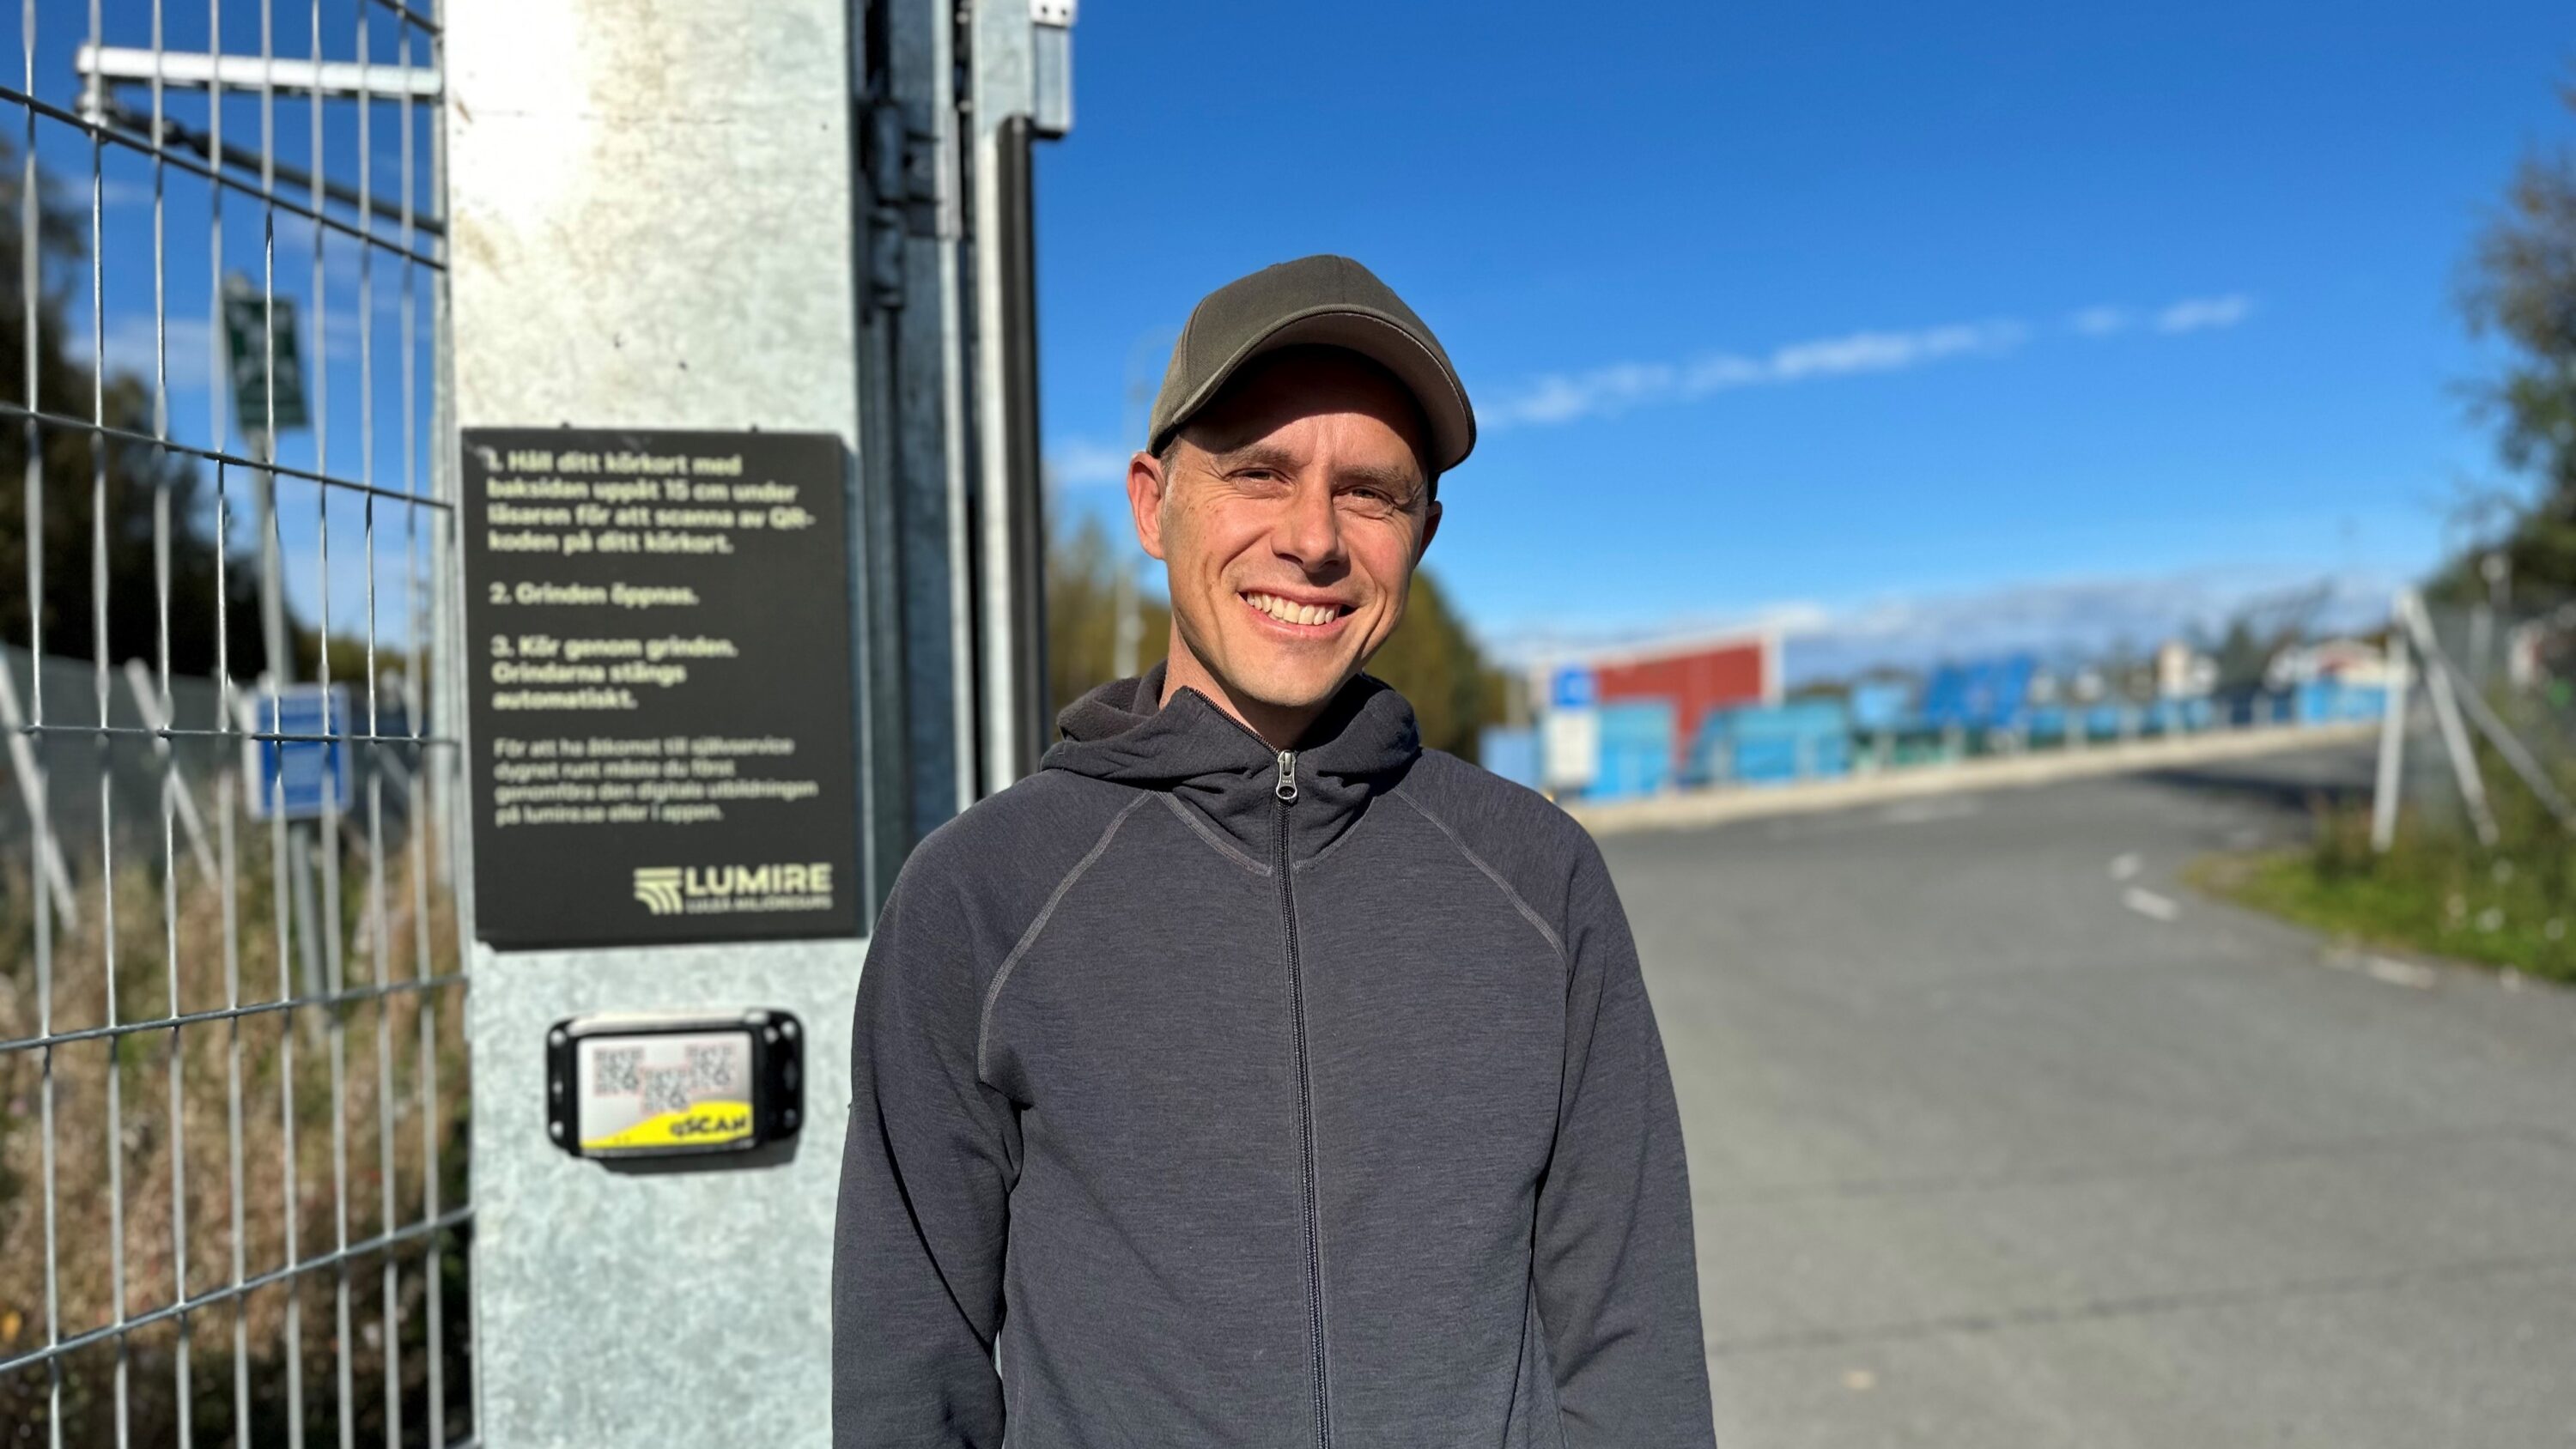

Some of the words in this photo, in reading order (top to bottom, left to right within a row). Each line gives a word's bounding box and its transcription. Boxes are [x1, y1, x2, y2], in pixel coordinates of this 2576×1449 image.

[486, 452, 504, 472] 1.
[507, 451, 554, 472] Håll
[556, 452, 601, 473] ditt
[605, 452, 690, 475] körkort
[692, 454, 743, 476] med
[487, 477, 589, 500] baksidan
[593, 479, 659, 503] uppåt
[692, 484, 729, 501] cm
[732, 482, 798, 502] under
[488, 504, 571, 527] läsaren
[575, 504, 611, 527] för
[615, 505, 652, 527] att
[655, 508, 735, 527] scanna
[738, 509, 765, 528] av
[488, 530, 559, 551] koden
[562, 530, 593, 555] på
[597, 530, 641, 552] ditt
[644, 530, 733, 554] körkort.
[489, 582, 512, 604] 2.
[515, 582, 607, 605] Grinden
[611, 582, 699, 608] öppnas.
[491, 634, 515, 658] 3.
[518, 635, 560, 658] Kör
[563, 640, 642, 661] genom
[645, 634, 738, 661] grinden.
[492, 662, 605, 683] Grindarna
[609, 661, 687, 687] stängs
[492, 688, 638, 710] automatiskt.
[494, 737, 527, 757] För
[528, 739, 556, 757] att
[495, 804, 522, 828] på
[686, 862, 834, 896] LUMIRE
